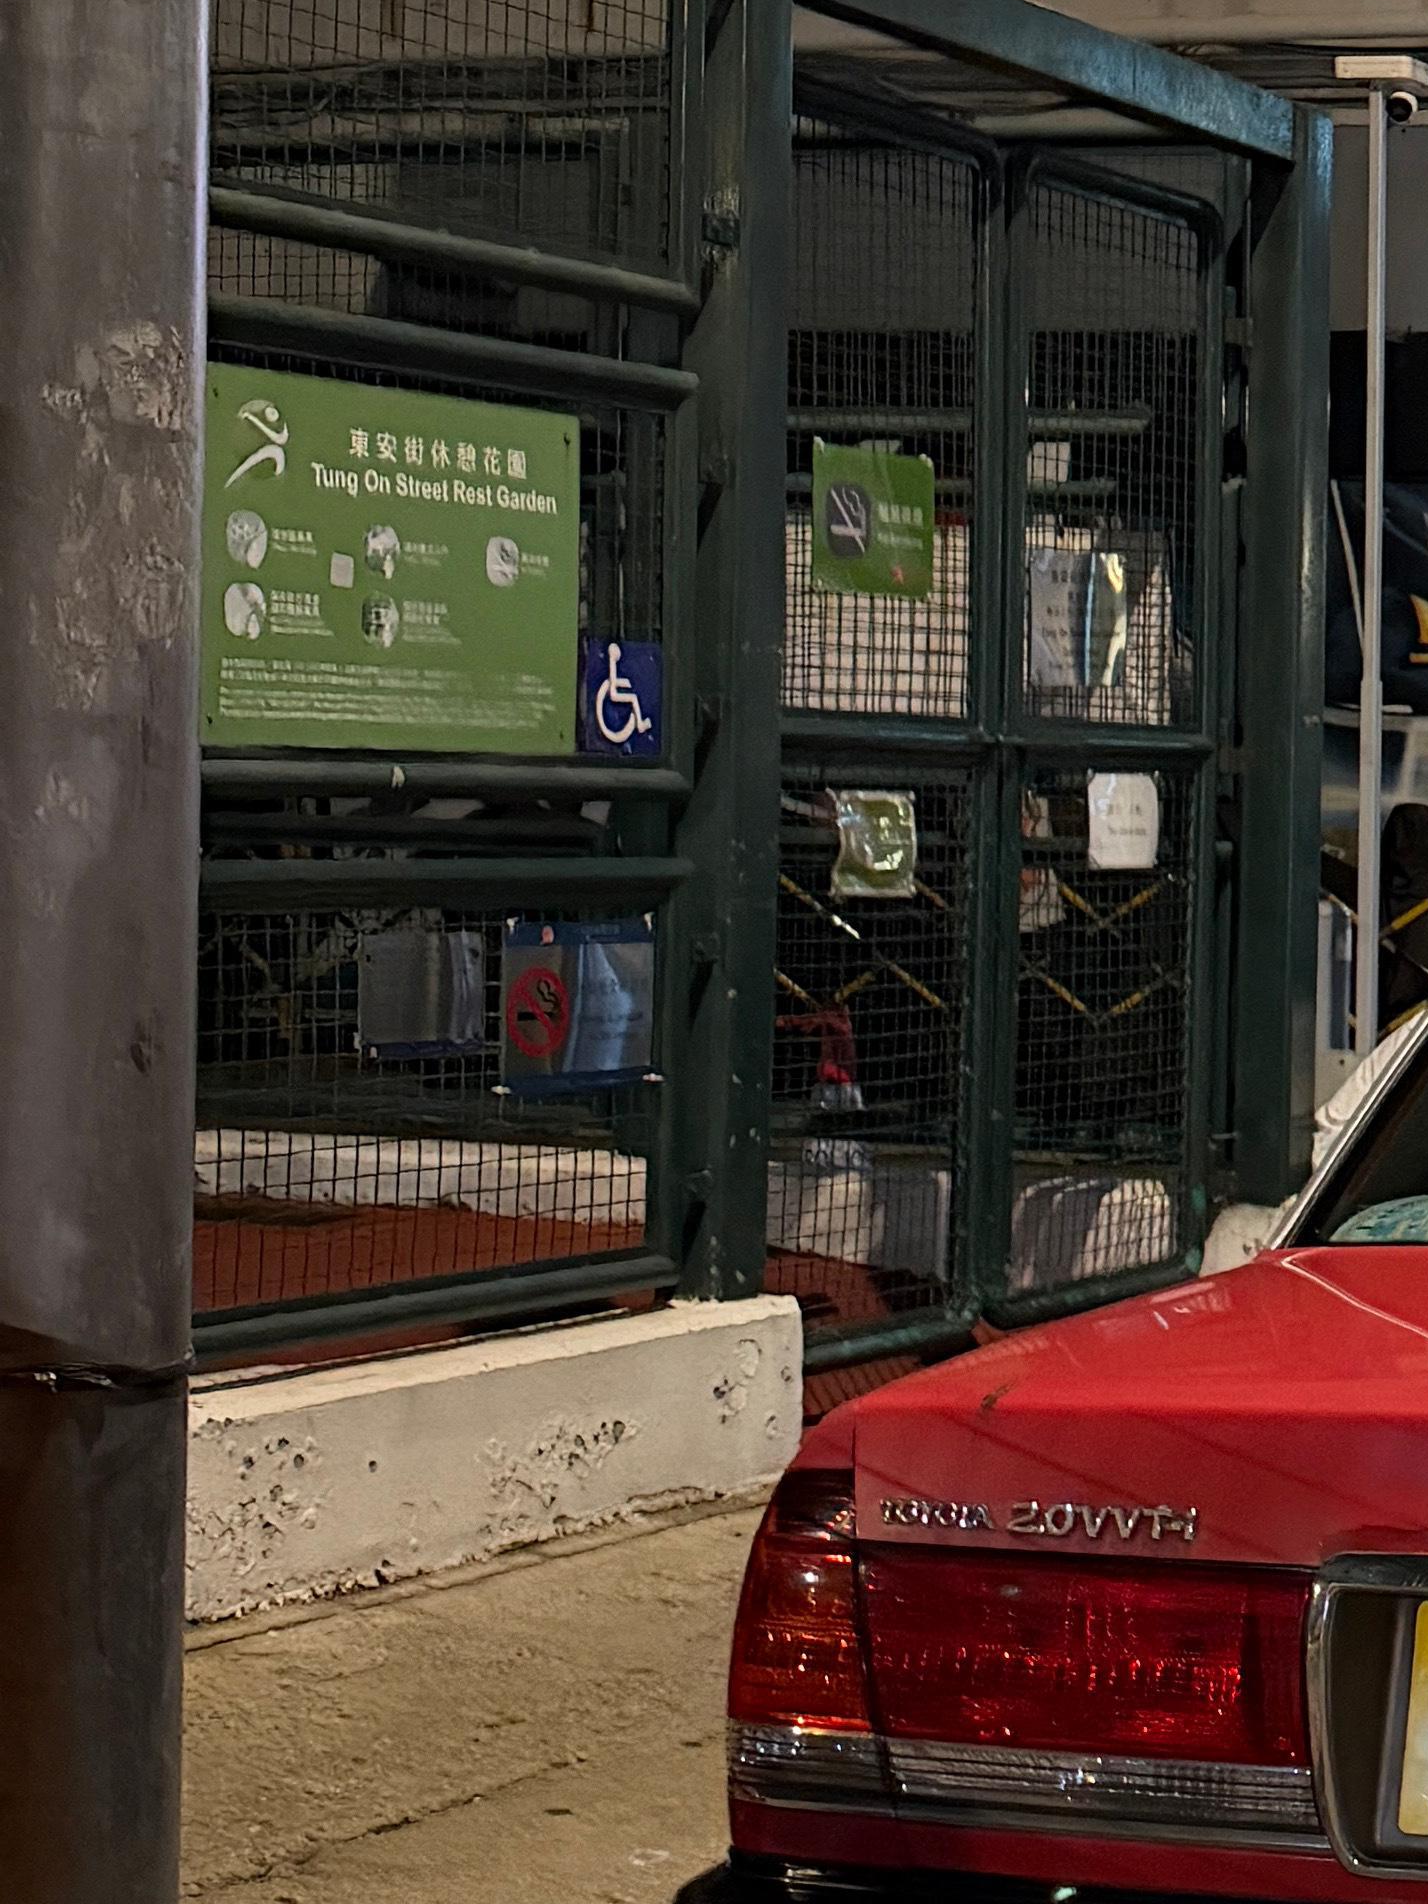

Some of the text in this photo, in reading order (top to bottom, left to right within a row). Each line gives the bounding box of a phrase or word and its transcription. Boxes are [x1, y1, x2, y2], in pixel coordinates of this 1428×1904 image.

[349, 427, 528, 480] 東安街休憩花園
[311, 462, 558, 515] Tung On Street Rest Garden
